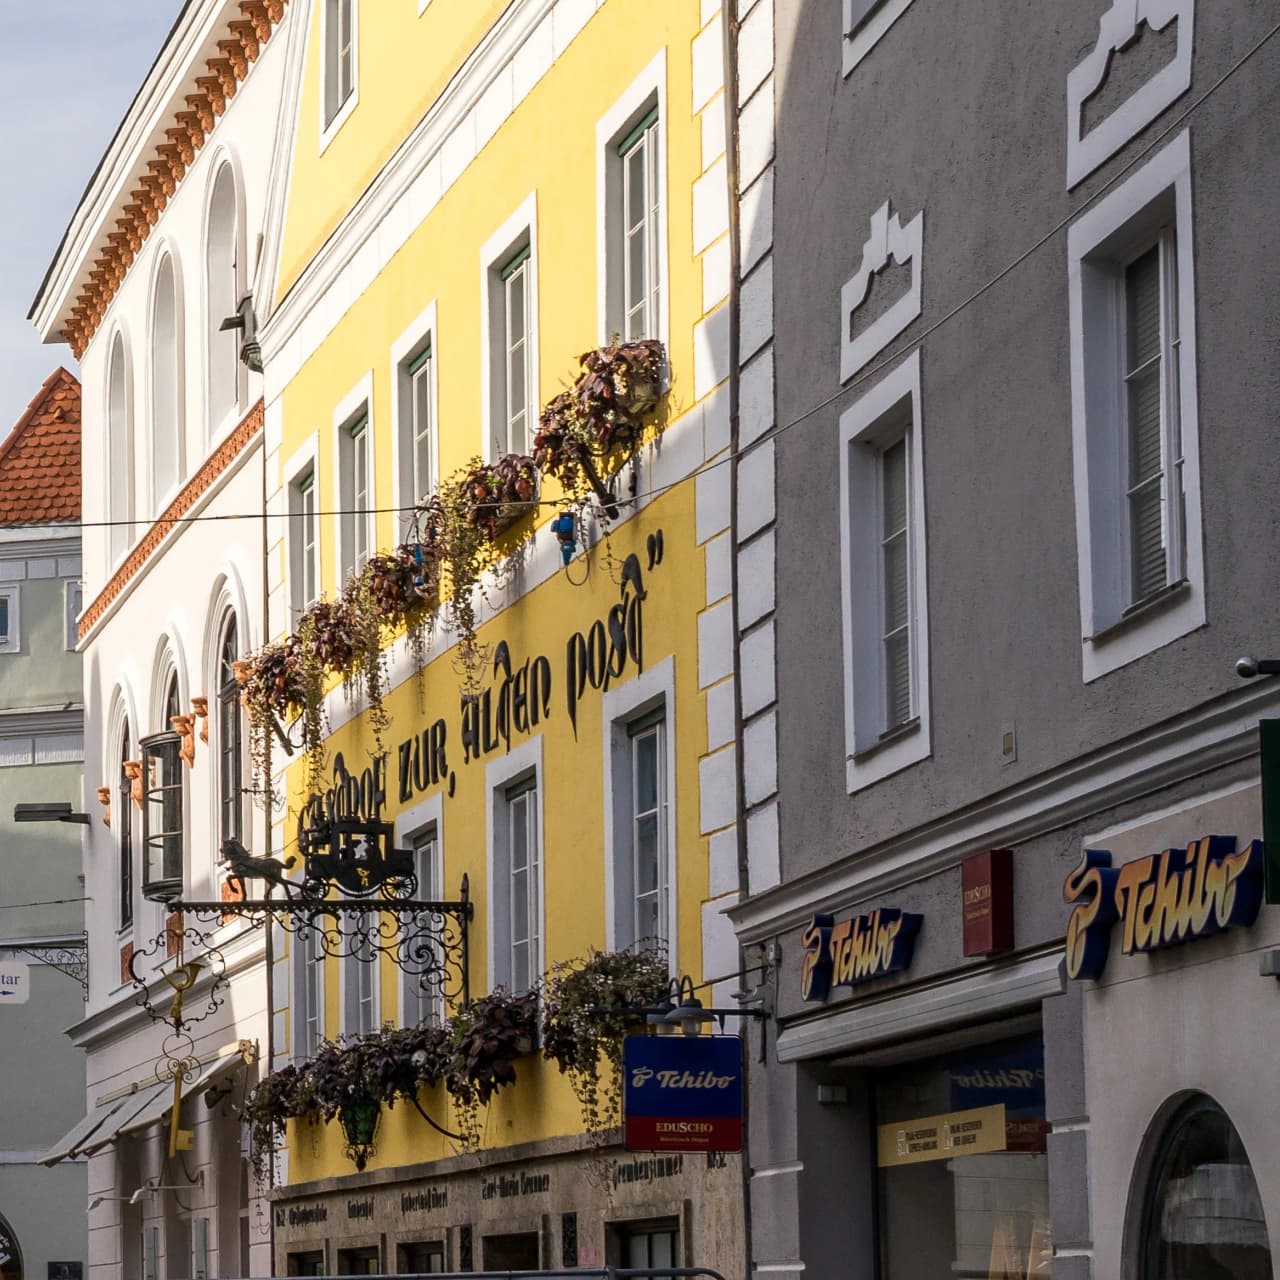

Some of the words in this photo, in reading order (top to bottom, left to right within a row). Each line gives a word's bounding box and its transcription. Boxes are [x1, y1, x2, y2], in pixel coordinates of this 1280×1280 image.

[1114, 835, 1254, 955] Tchibo
[829, 908, 904, 987] Tchibo
[656, 1070, 737, 1089] Tchibo
[655, 1122, 714, 1133] EDUSCHO
